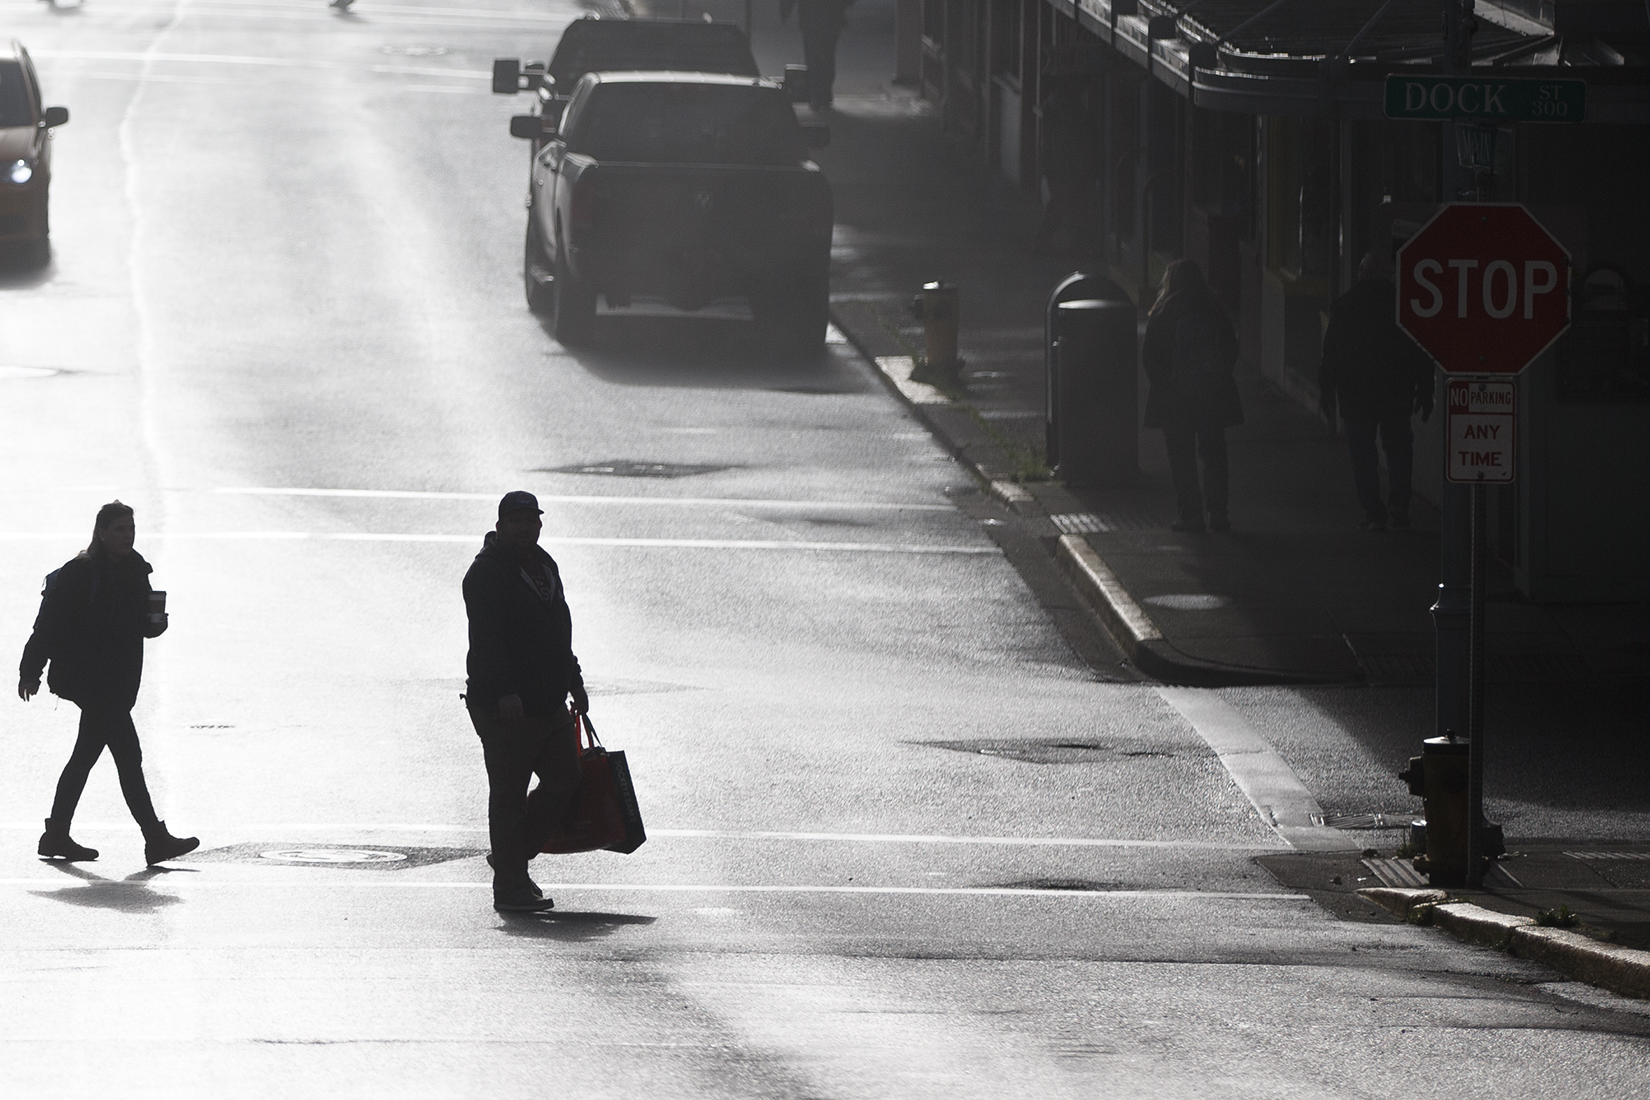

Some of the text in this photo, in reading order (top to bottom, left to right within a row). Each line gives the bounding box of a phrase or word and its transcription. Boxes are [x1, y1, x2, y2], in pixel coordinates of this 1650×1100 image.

[1404, 82, 1563, 113] DOCK ST
[1532, 101, 1568, 116] 300
[1410, 258, 1558, 320] STOP
[1450, 388, 1511, 406] NO PARKING
[1464, 425, 1500, 439] ANY
[1458, 451, 1502, 466] TIME
[615, 760, 631, 797] SOCKEYE
